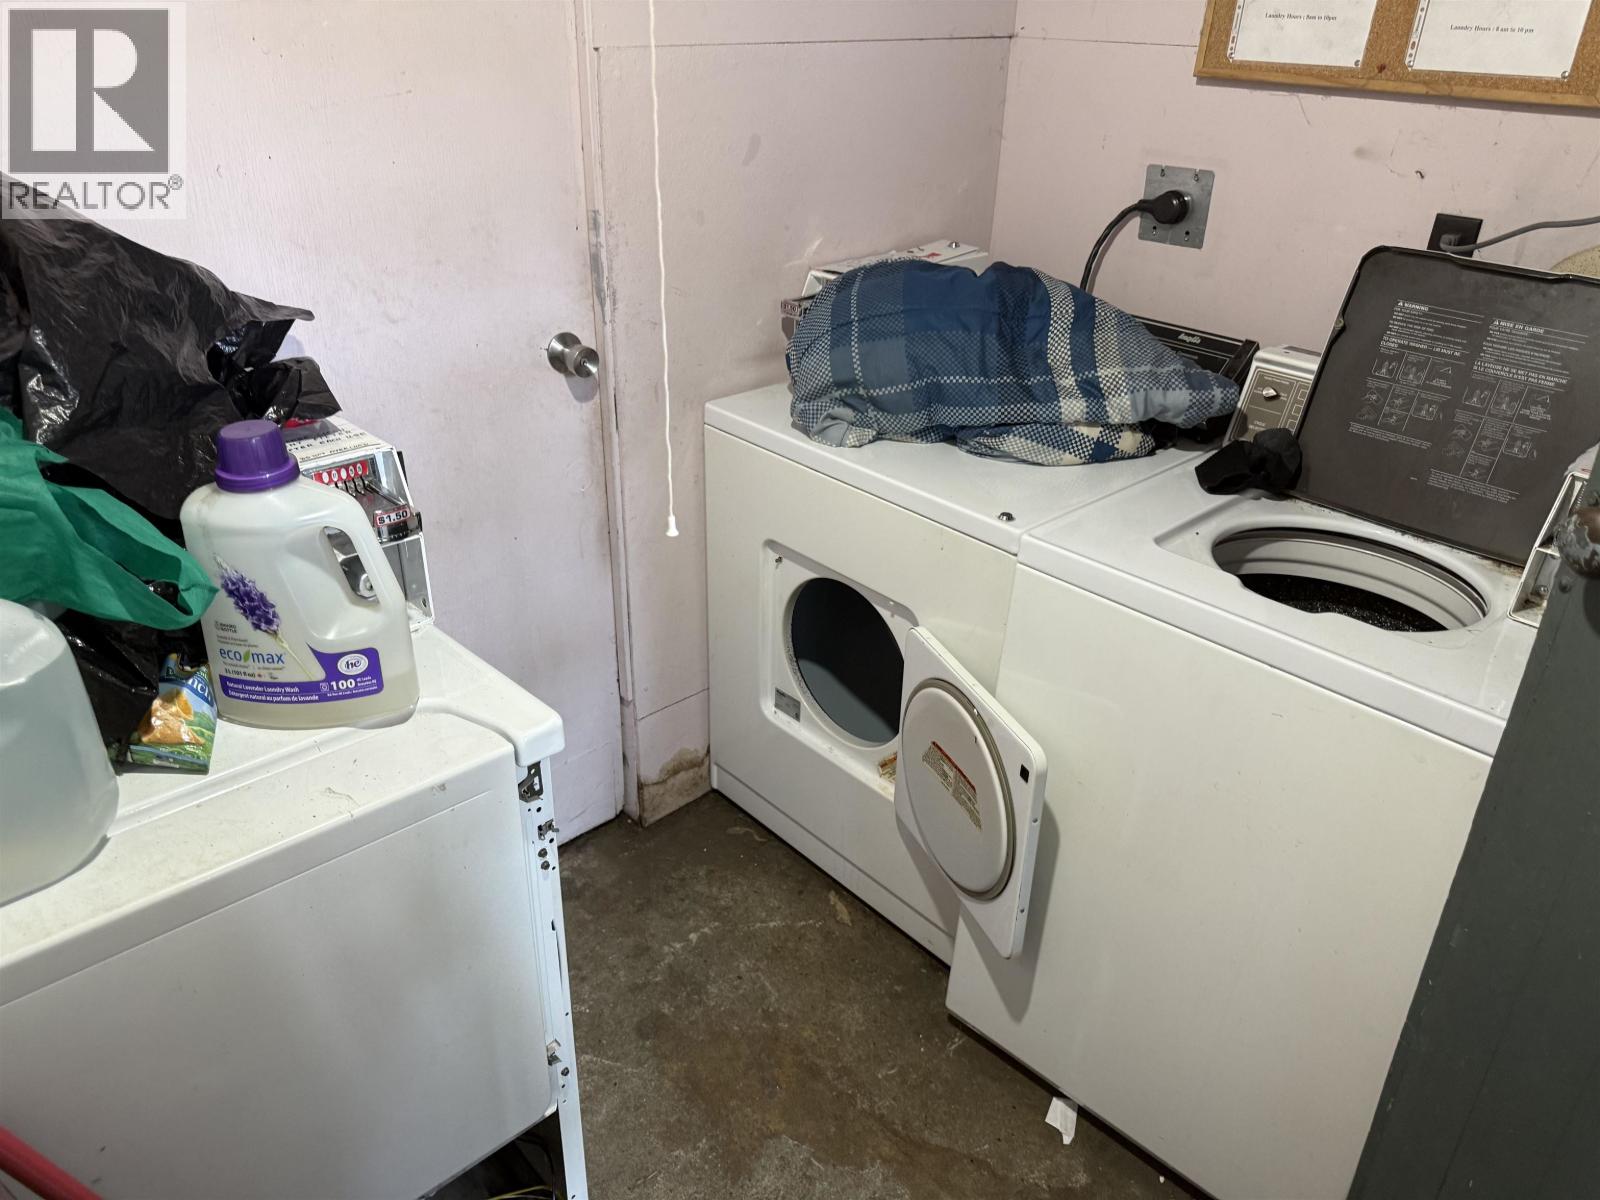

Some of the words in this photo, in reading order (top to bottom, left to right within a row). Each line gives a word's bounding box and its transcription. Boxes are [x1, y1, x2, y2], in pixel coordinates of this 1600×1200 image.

[1265, 12, 1285, 20] Laundry
[1450, 24, 1472, 32] Laundry
[1404, 302, 1429, 311] WARNING
[288, 443, 312, 452] FTER
[378, 510, 408, 525] $1.50
[219, 648, 242, 662] eco
[252, 651, 285, 665] max
[345, 660, 361, 670] he
[243, 684, 264, 692] Lavender
[264, 686, 284, 694] Laundry
[330, 678, 356, 690] 100
